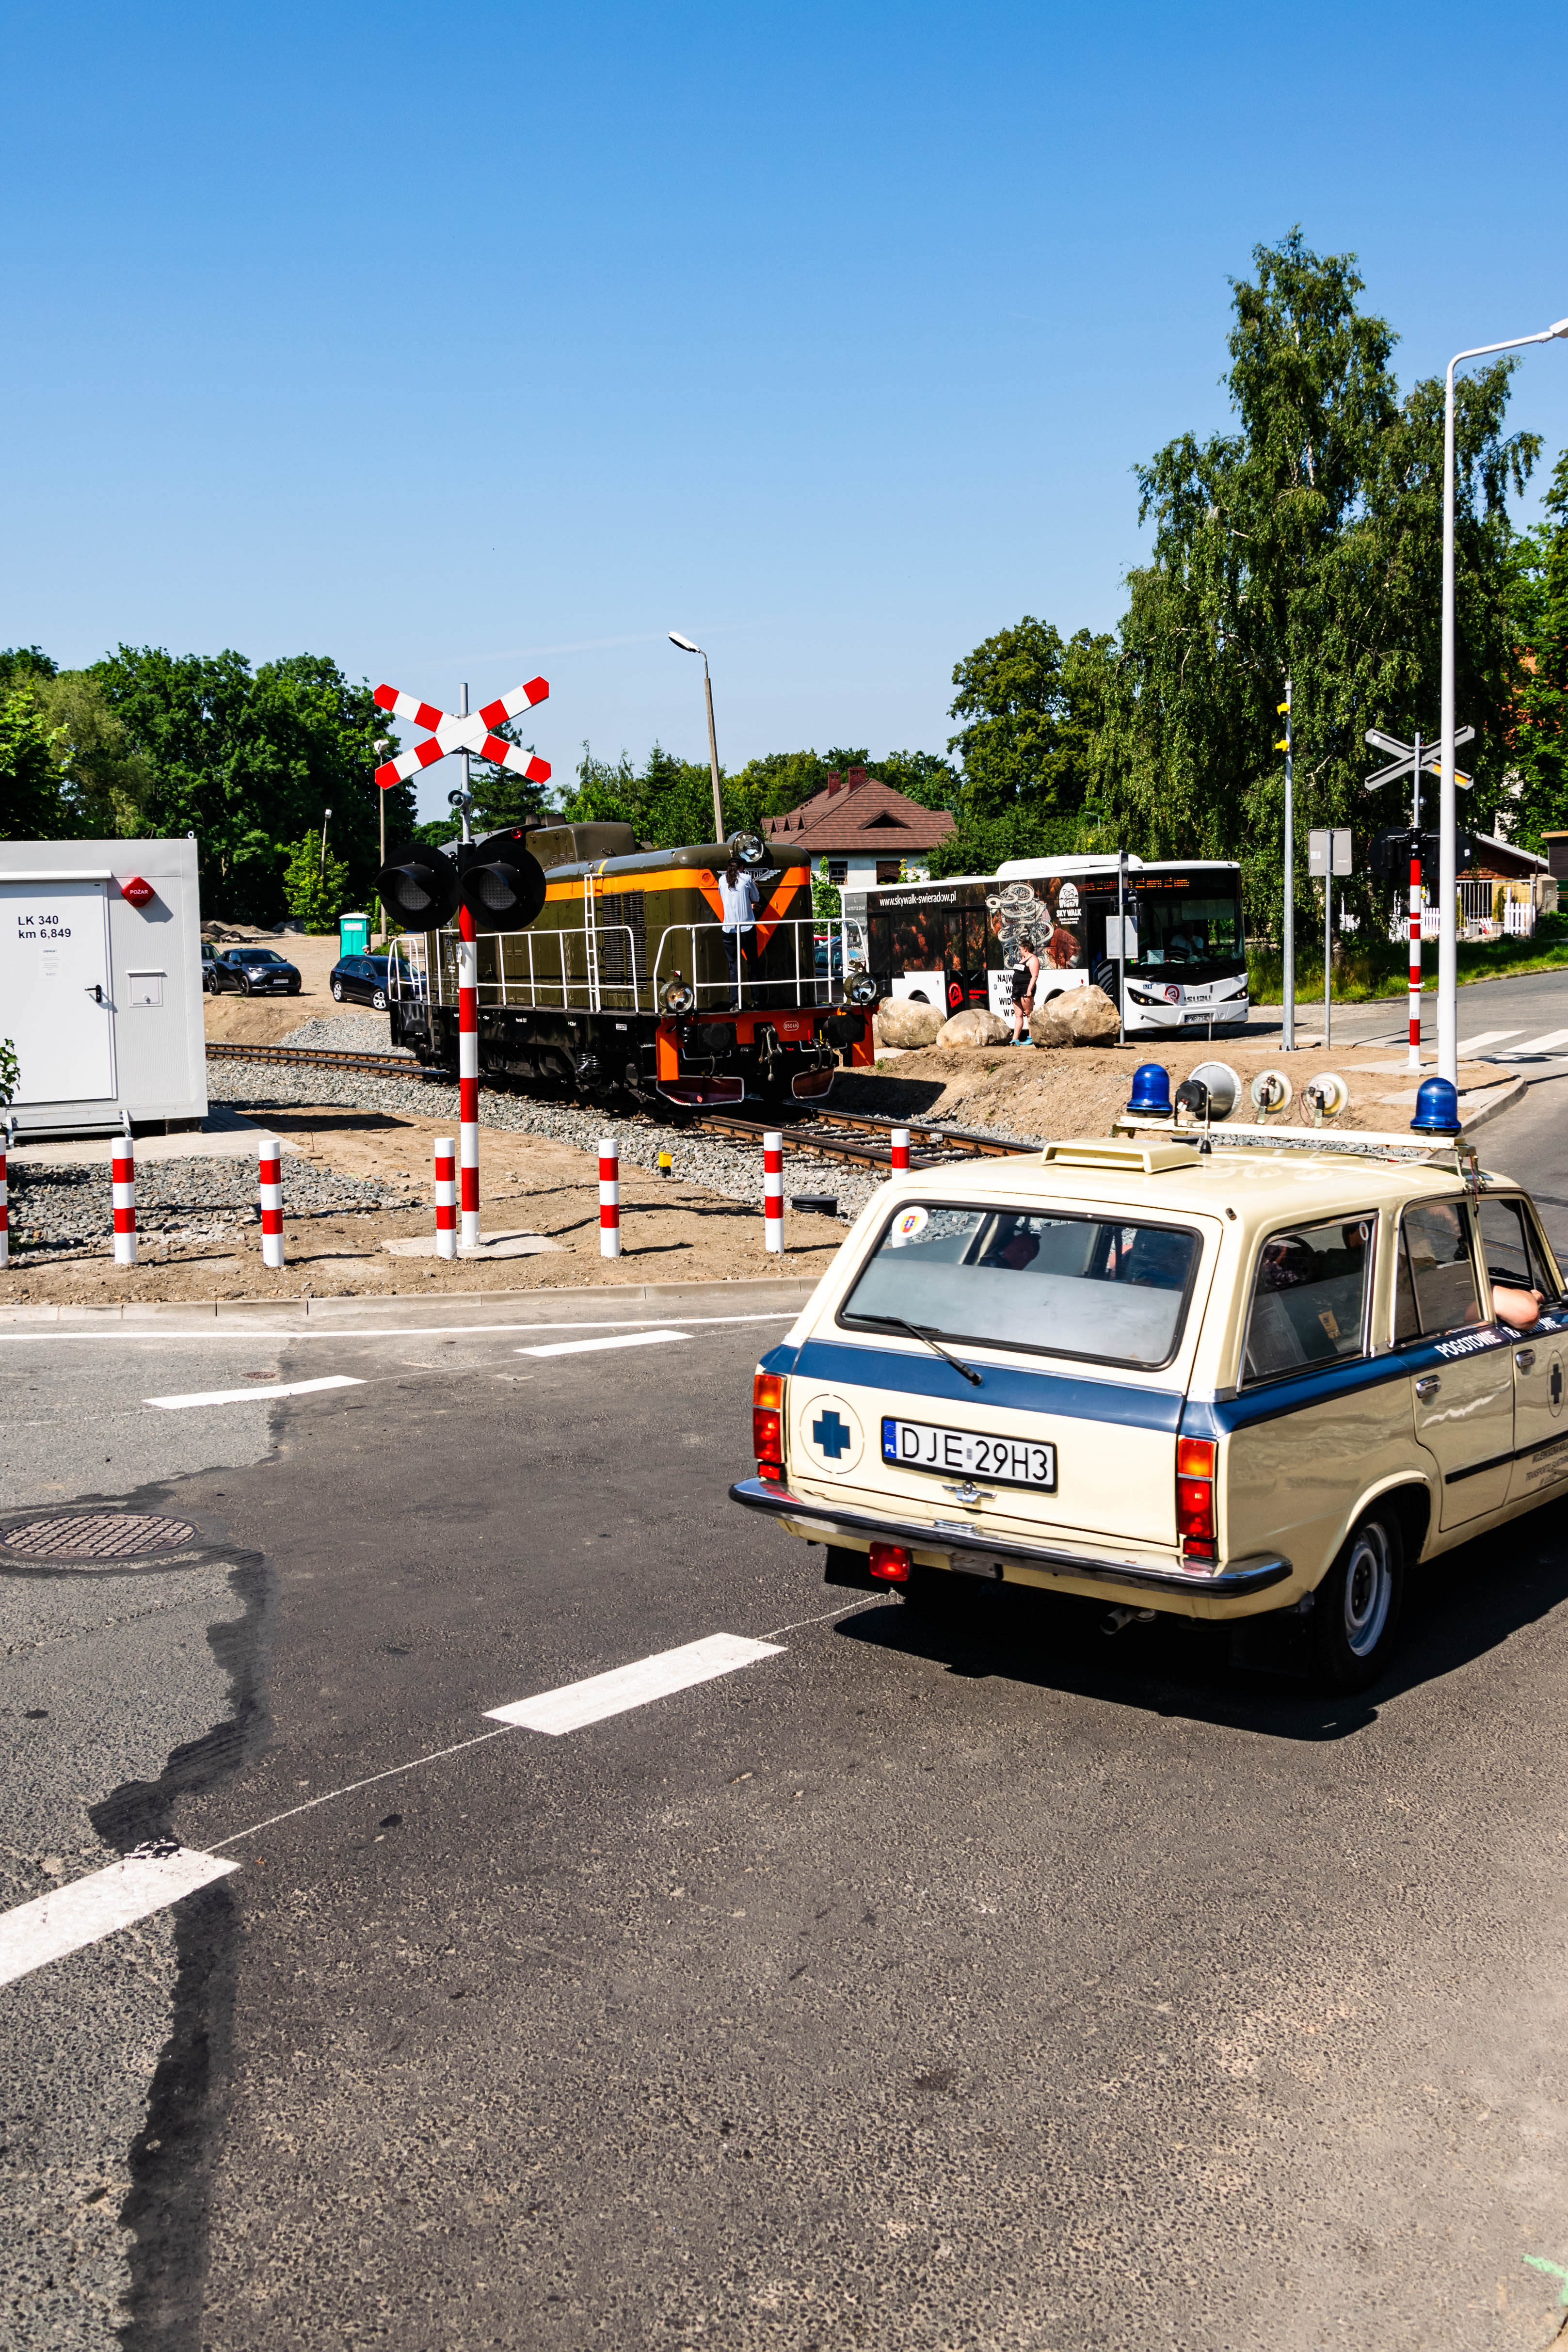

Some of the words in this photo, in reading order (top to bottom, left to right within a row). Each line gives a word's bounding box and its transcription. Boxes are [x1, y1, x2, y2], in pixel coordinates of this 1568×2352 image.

[880, 891, 956, 907] www.skywalk-swieradow.pl
[18, 916, 34, 925] LK
[38, 915, 59, 925] 340
[18, 929, 36, 939] km
[40, 928, 71, 940] 6,849
[1434, 1330, 1502, 1358] POGOTOWIE
[885, 1443, 896, 1454] PL
[902, 1427, 963, 1468] DJE
[976, 1440, 1047, 1481] 29H3
